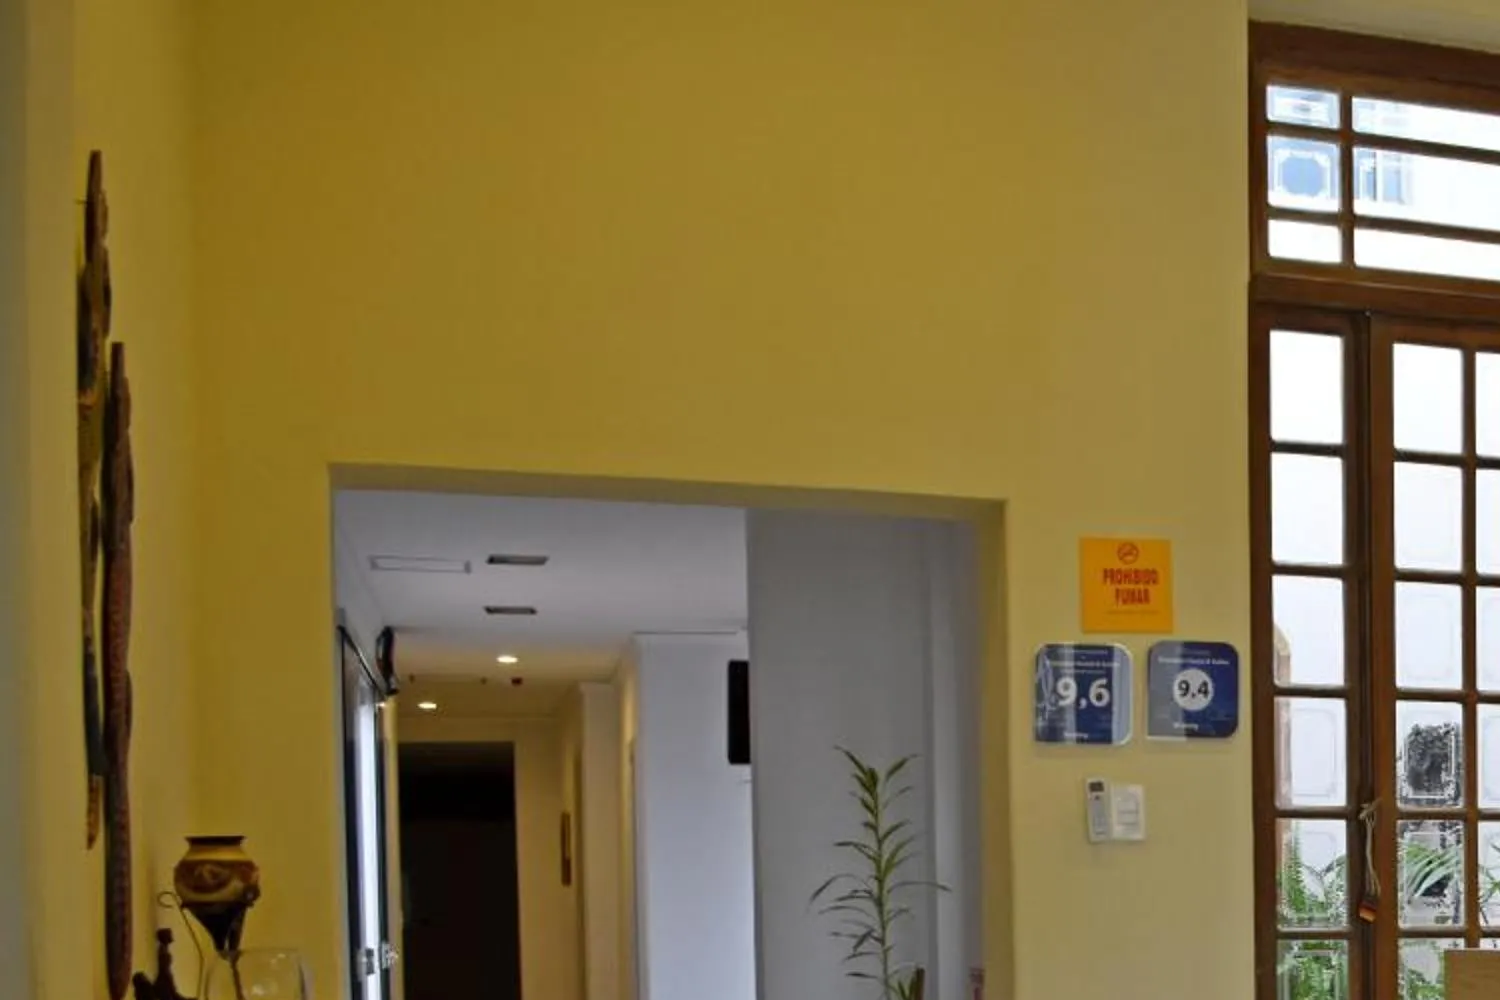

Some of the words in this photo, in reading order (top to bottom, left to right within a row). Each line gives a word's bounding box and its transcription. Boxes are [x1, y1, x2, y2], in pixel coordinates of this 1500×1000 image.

[1103, 567, 1160, 585] PROHIBIDO
[1115, 587, 1151, 605] FUMAR
[1056, 676, 1110, 709] 9,6
